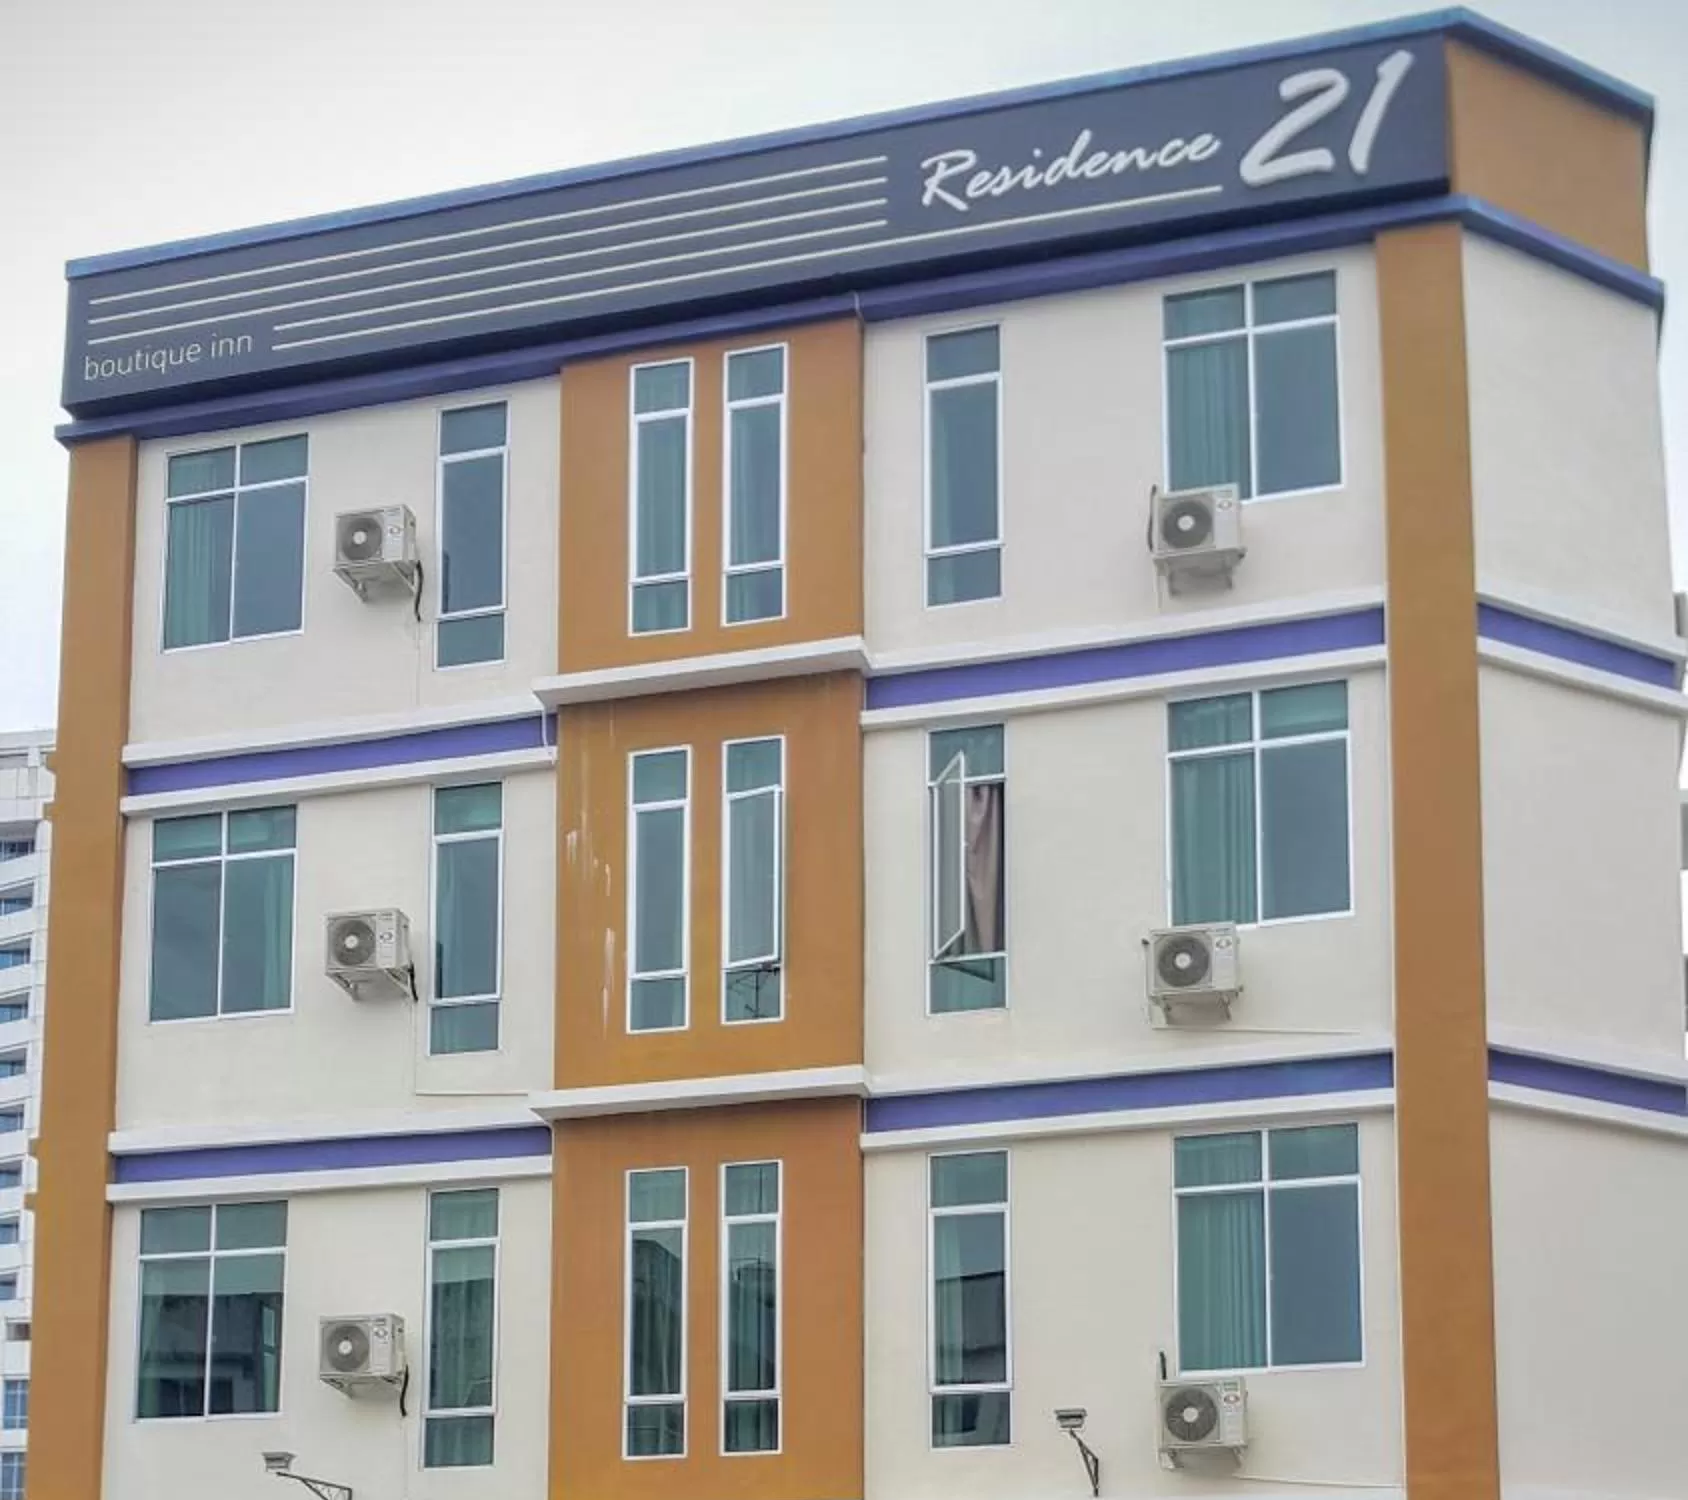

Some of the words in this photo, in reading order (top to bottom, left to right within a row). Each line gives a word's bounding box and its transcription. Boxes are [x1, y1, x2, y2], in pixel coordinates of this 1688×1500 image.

[921, 130, 1221, 211] Residence
[1239, 50, 1414, 187] 21
[84, 342, 201, 381] boutique
[210, 332, 253, 358] inn
